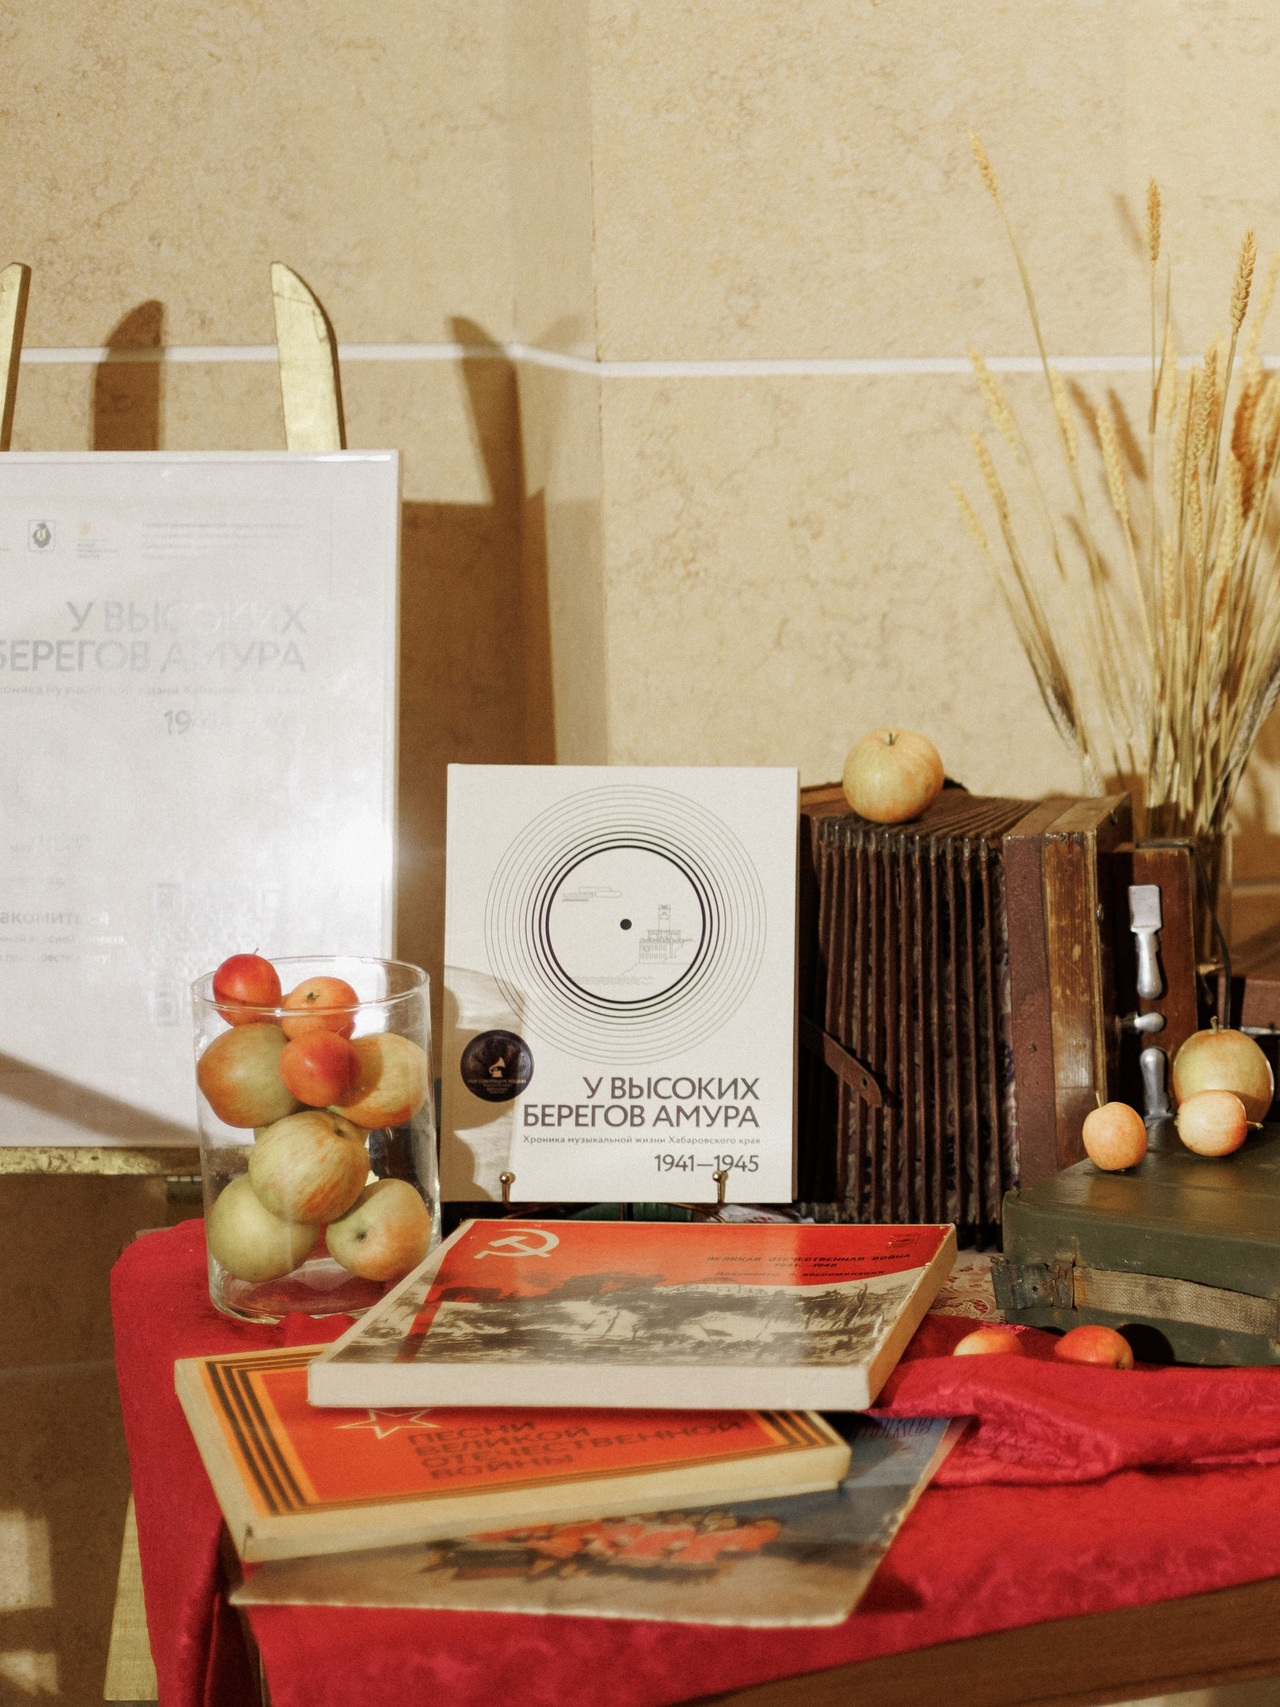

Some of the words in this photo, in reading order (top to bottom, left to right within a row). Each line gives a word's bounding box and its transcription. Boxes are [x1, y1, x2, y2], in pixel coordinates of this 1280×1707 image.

[66, 600, 95, 633] У
[582, 1076, 604, 1099] У
[611, 1077, 761, 1100] ВЫСОКИХ
[523, 1104, 646, 1127] БЕРЕГОВ
[652, 1105, 760, 1128] АМУРА
[523, 1134, 566, 1145] Хроника
[567, 1136, 632, 1146] музыкальной
[668, 1136, 737, 1146] Хабаровского
[738, 1138, 761, 1146] края
[654, 1154, 760, 1172] 1941—1945
[408, 1421, 536, 1445] ПЕСНИ
[414, 1425, 591, 1457] ВЕЛИКОЙ
[421, 1419, 745, 1470] ОТЕЧЕСТВЕННОЙ
[430, 1453, 575, 1480] ВОЙНЫ
